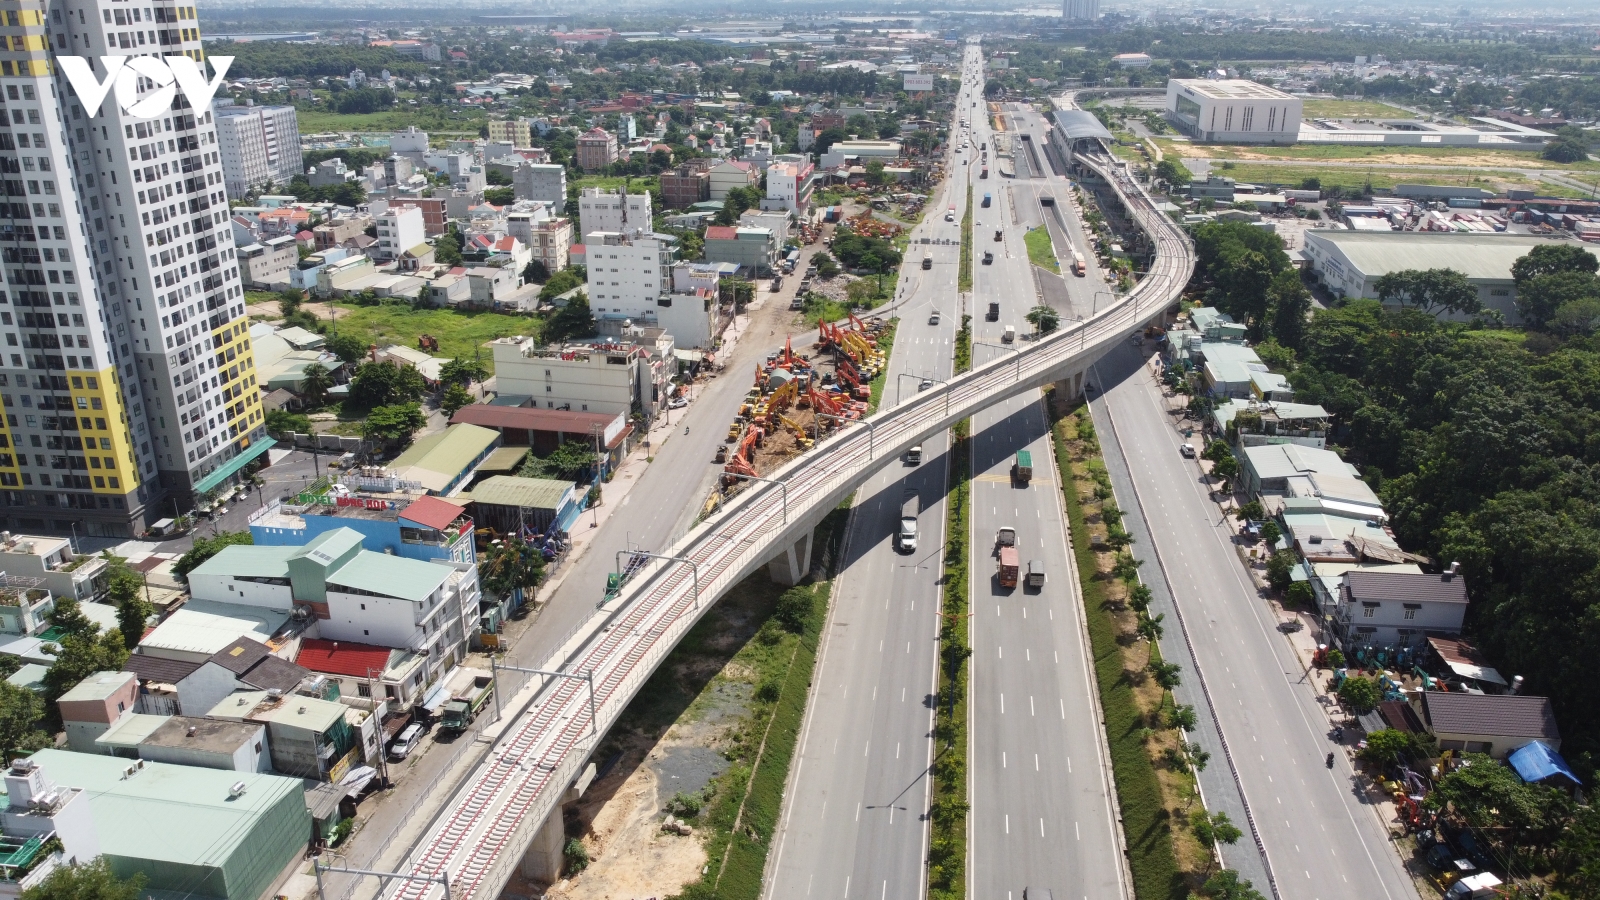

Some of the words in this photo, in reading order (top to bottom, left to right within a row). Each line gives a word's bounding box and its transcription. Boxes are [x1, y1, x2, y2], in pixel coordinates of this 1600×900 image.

[299, 494, 334, 506] MOTEL
[366, 499, 387, 510] HOA
[389, 501, 396, 511] 2
